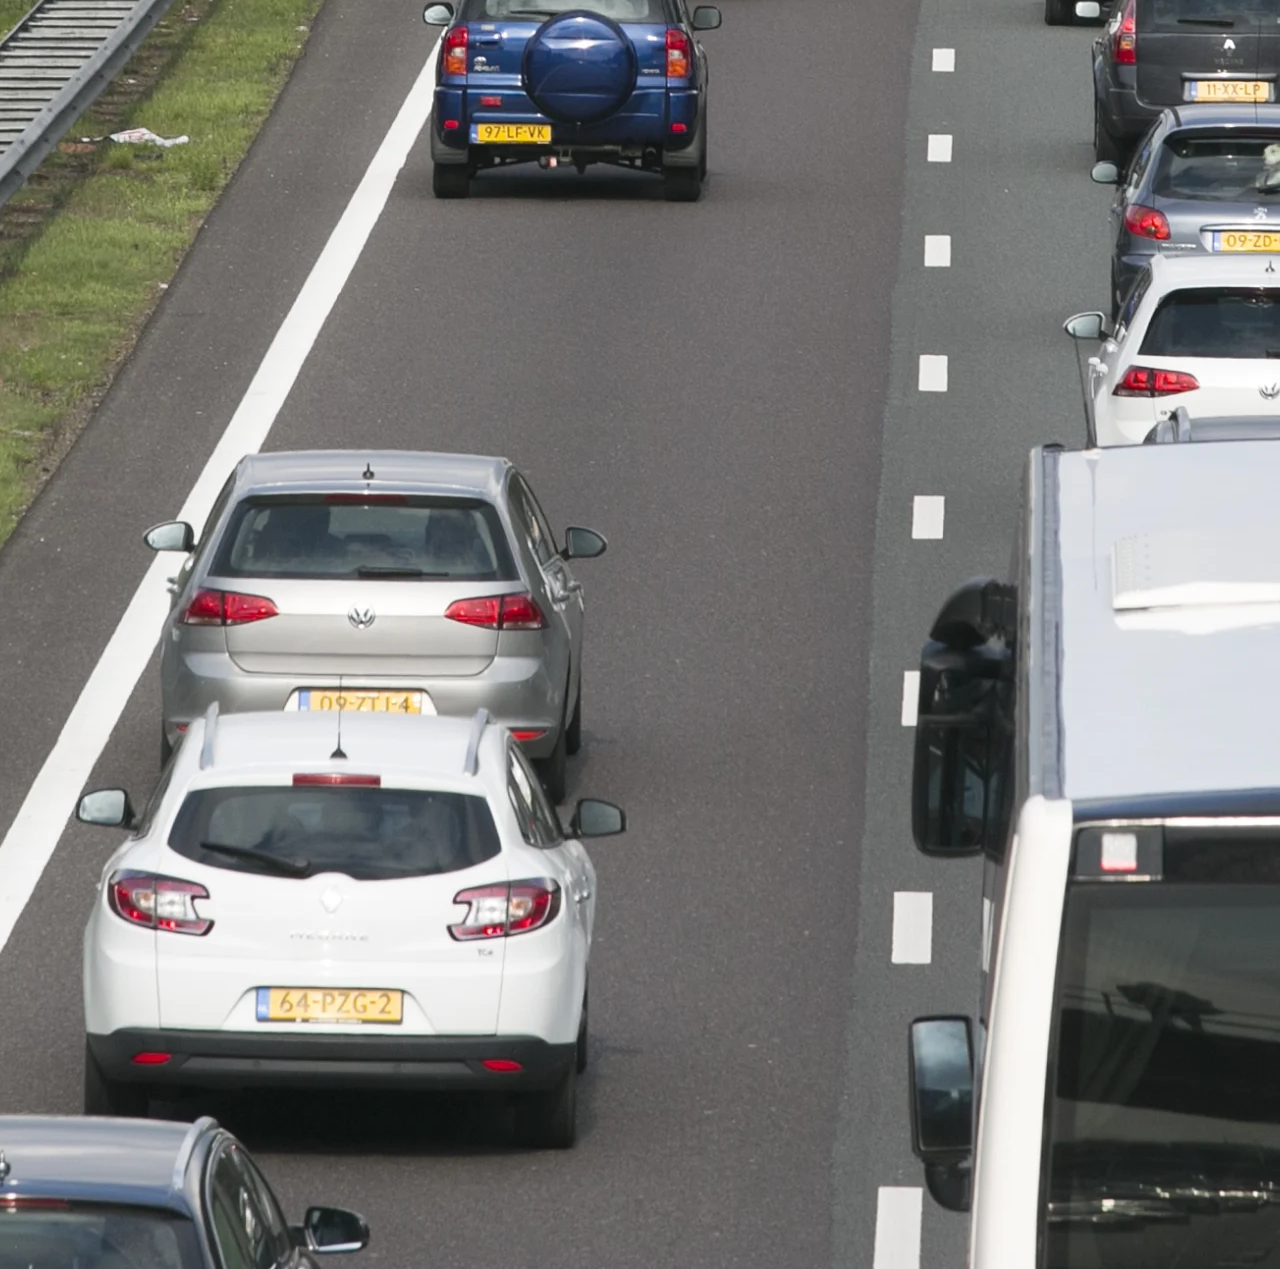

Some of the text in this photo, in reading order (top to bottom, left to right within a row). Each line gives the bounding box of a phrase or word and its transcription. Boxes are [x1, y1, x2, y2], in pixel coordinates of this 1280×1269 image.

[1207, 83, 1261, 96] 11-XX-LP
[484, 126, 546, 140] 97-LF-VK
[279, 991, 392, 1016] 64-PZG-2
